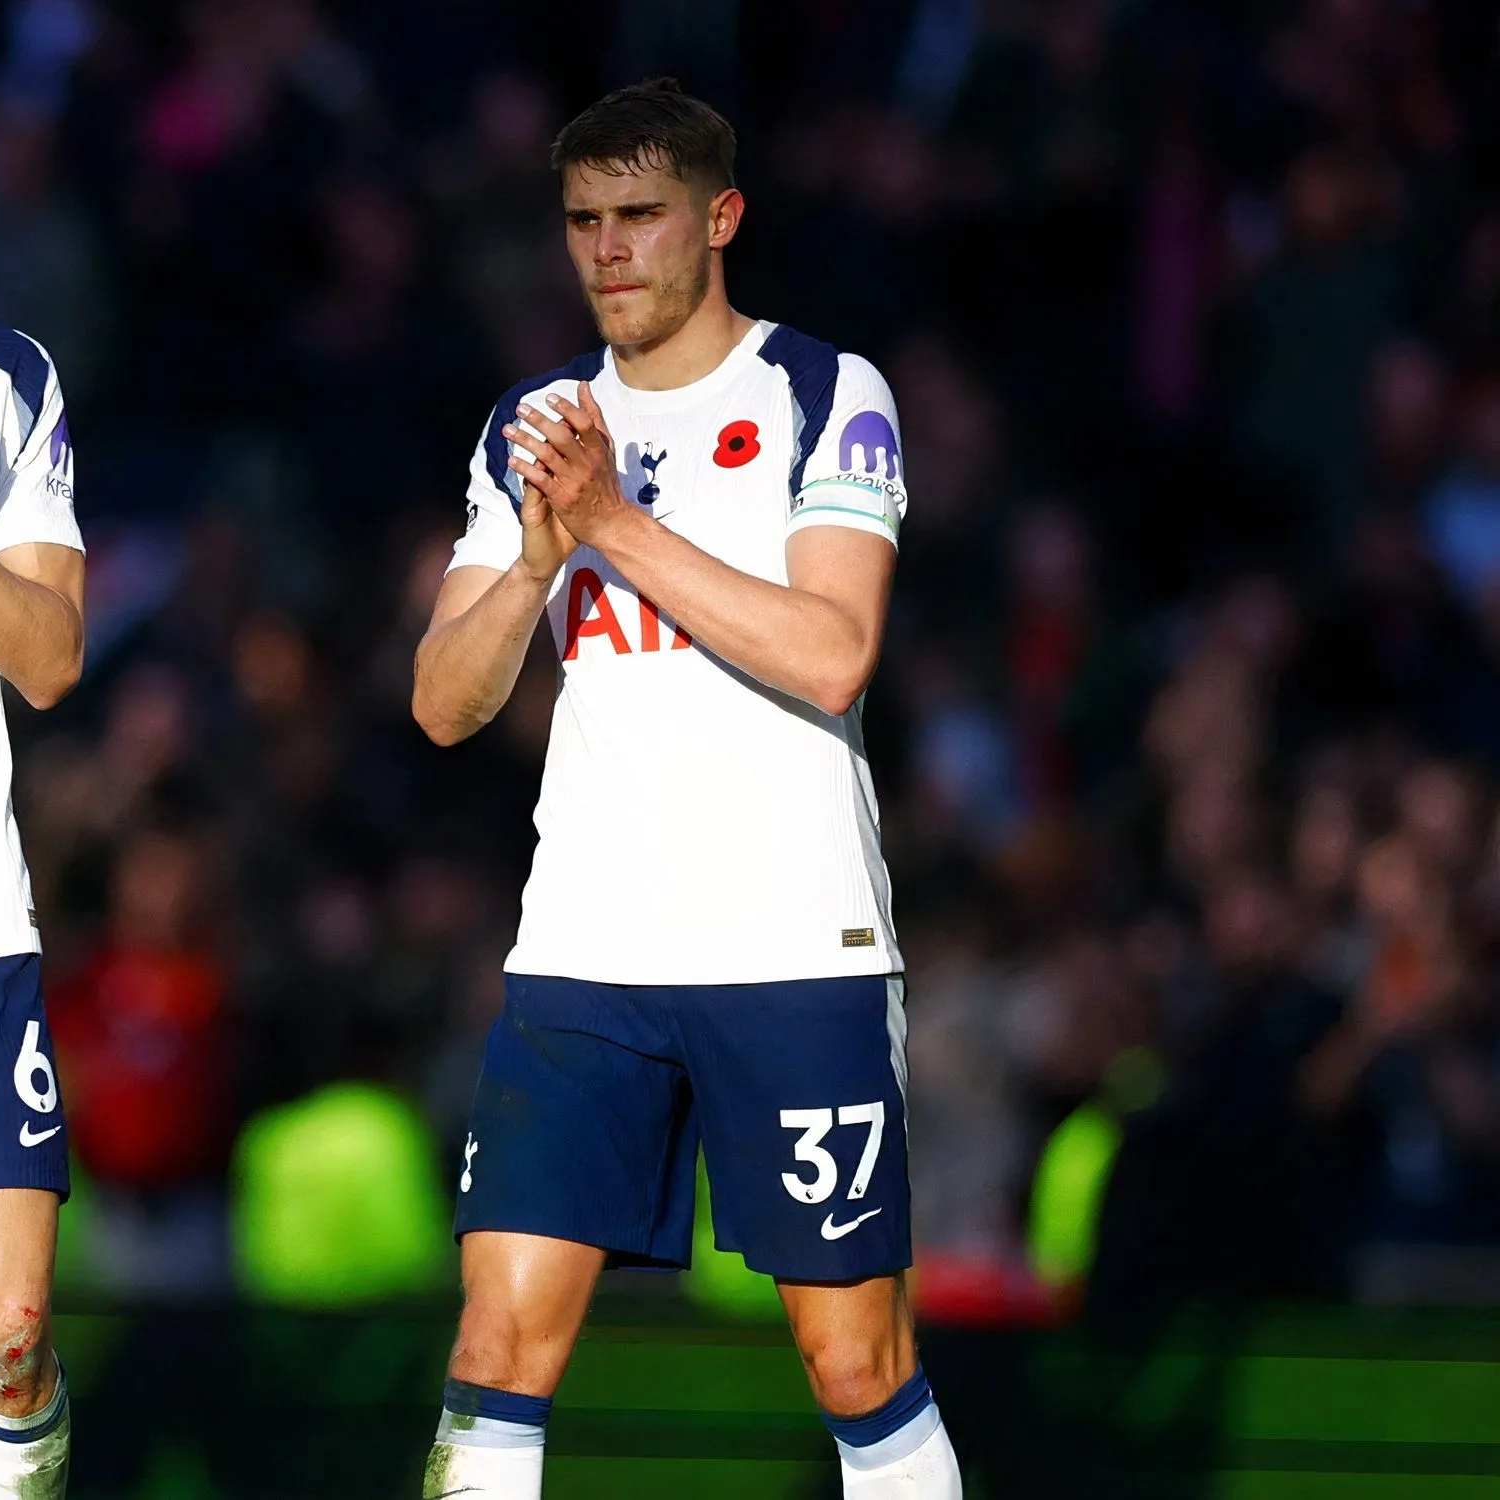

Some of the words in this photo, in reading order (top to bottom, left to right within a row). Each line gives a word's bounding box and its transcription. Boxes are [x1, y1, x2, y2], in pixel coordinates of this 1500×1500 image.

[562, 567, 693, 662] AI
[14, 1020, 57, 1113] 6
[780, 1101, 885, 1204] 37
